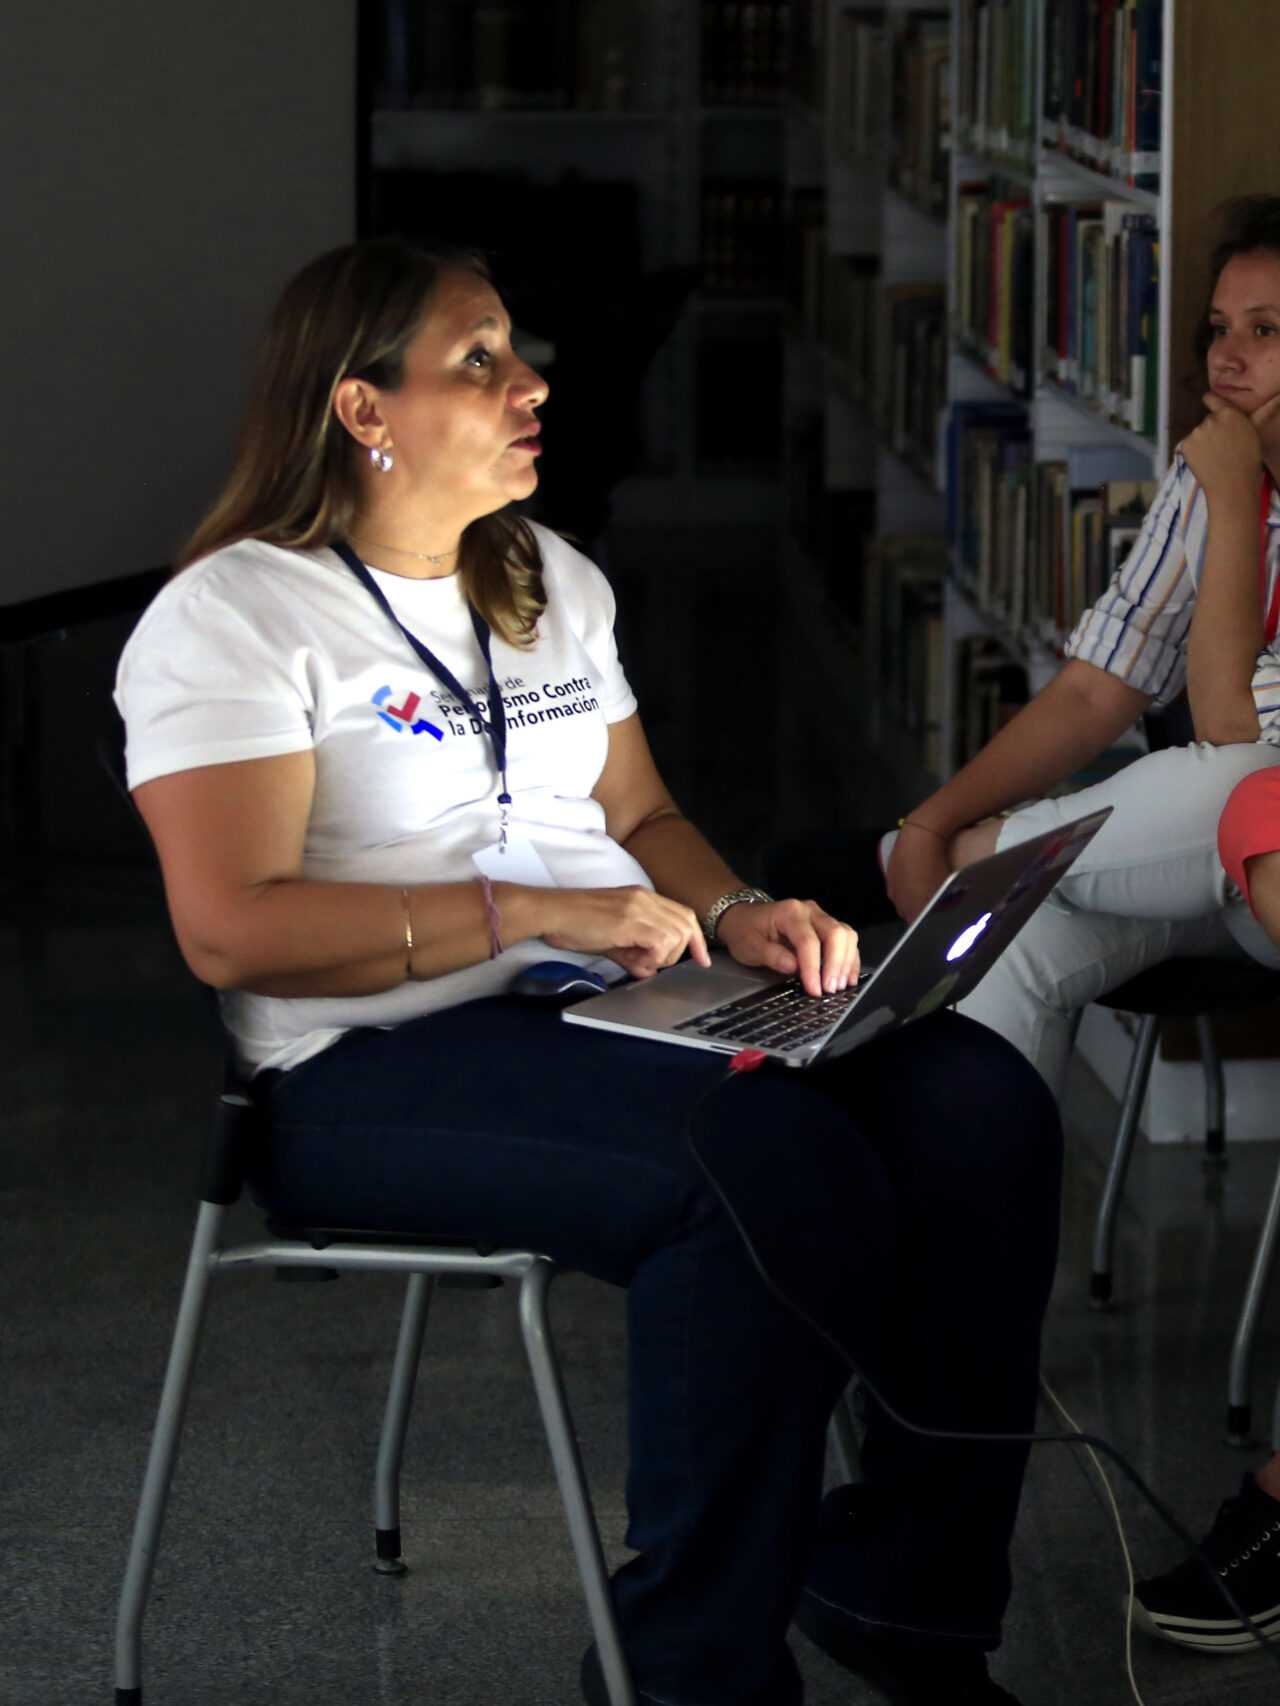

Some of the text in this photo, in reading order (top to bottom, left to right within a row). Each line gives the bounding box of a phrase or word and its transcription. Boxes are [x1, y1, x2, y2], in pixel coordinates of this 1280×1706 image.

[504, 676, 526, 690] de
[542, 677, 592, 699] Contra
[448, 694, 600, 736] la Dnformación
